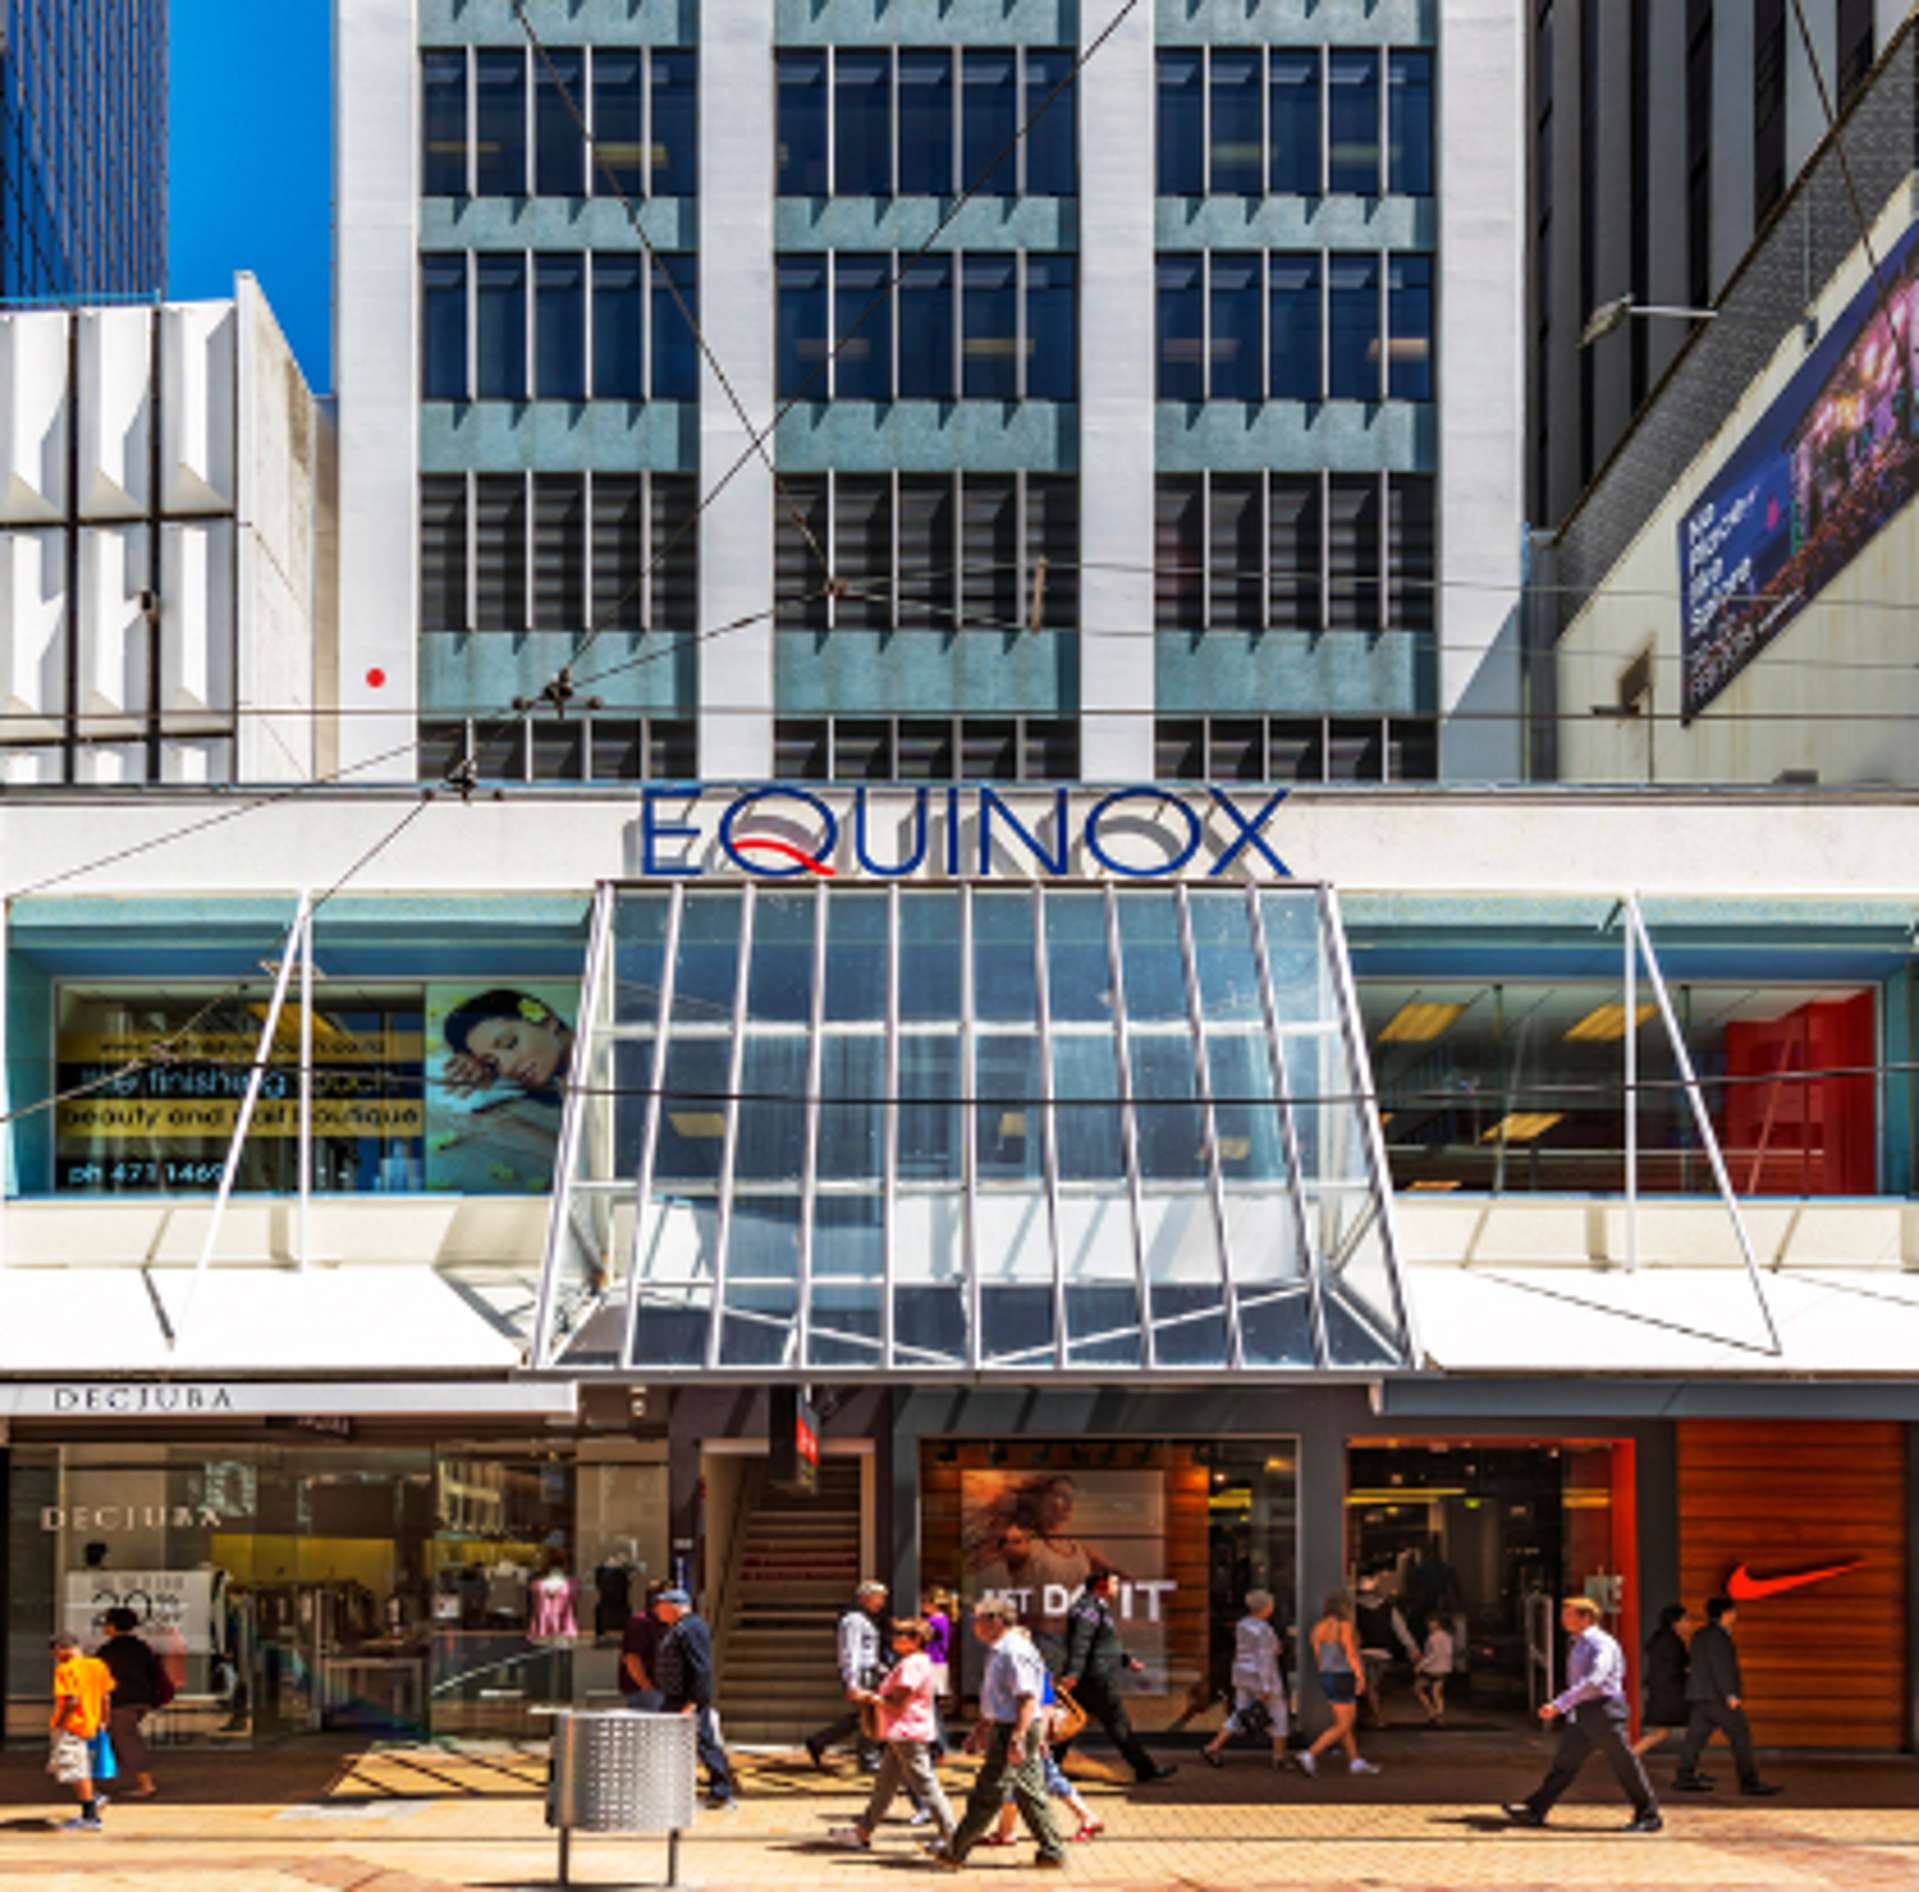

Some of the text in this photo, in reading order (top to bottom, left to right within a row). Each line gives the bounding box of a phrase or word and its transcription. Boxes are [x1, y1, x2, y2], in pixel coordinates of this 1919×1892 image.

[642, 786, 1292, 877] EQUINOX
[309, 1069, 398, 1094] ouch
[64, 1107, 159, 1128] beauty
[170, 1106, 224, 1124] and
[53, 1387, 232, 1411] DECJUBA
[40, 1506, 222, 1532] DECJUBA
[1121, 1579, 1179, 1622] IT
